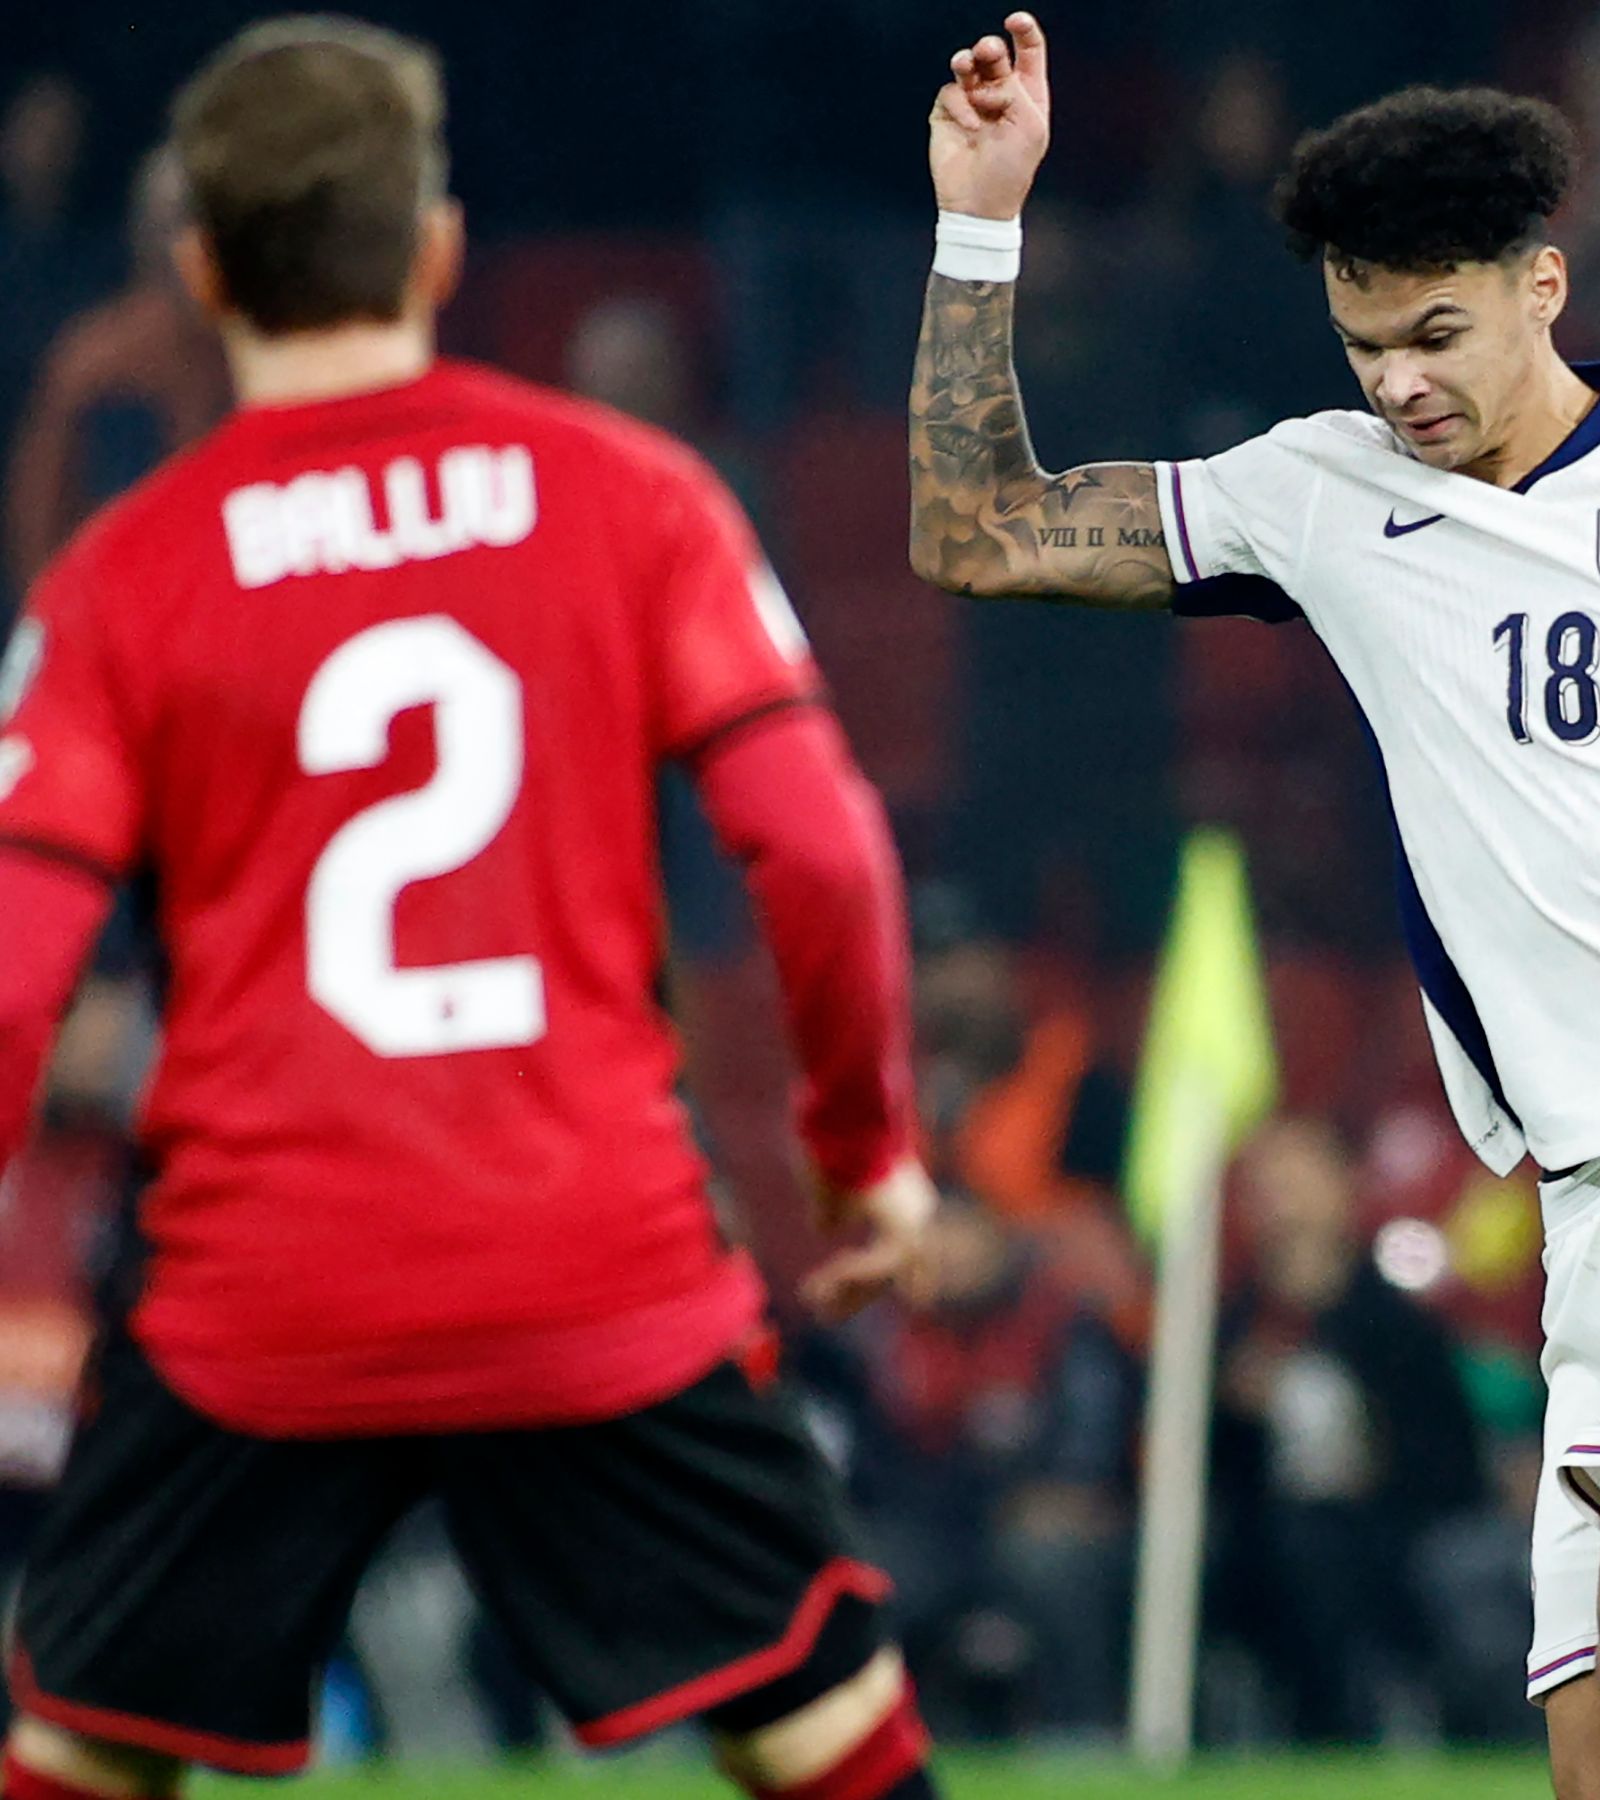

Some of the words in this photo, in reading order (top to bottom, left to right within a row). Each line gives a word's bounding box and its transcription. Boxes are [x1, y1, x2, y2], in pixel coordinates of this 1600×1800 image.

[222, 444, 538, 590] BALLIU
[1039, 527, 1077, 548] VIII
[1087, 527, 1105, 547] II
[296, 613, 548, 1058] 2
